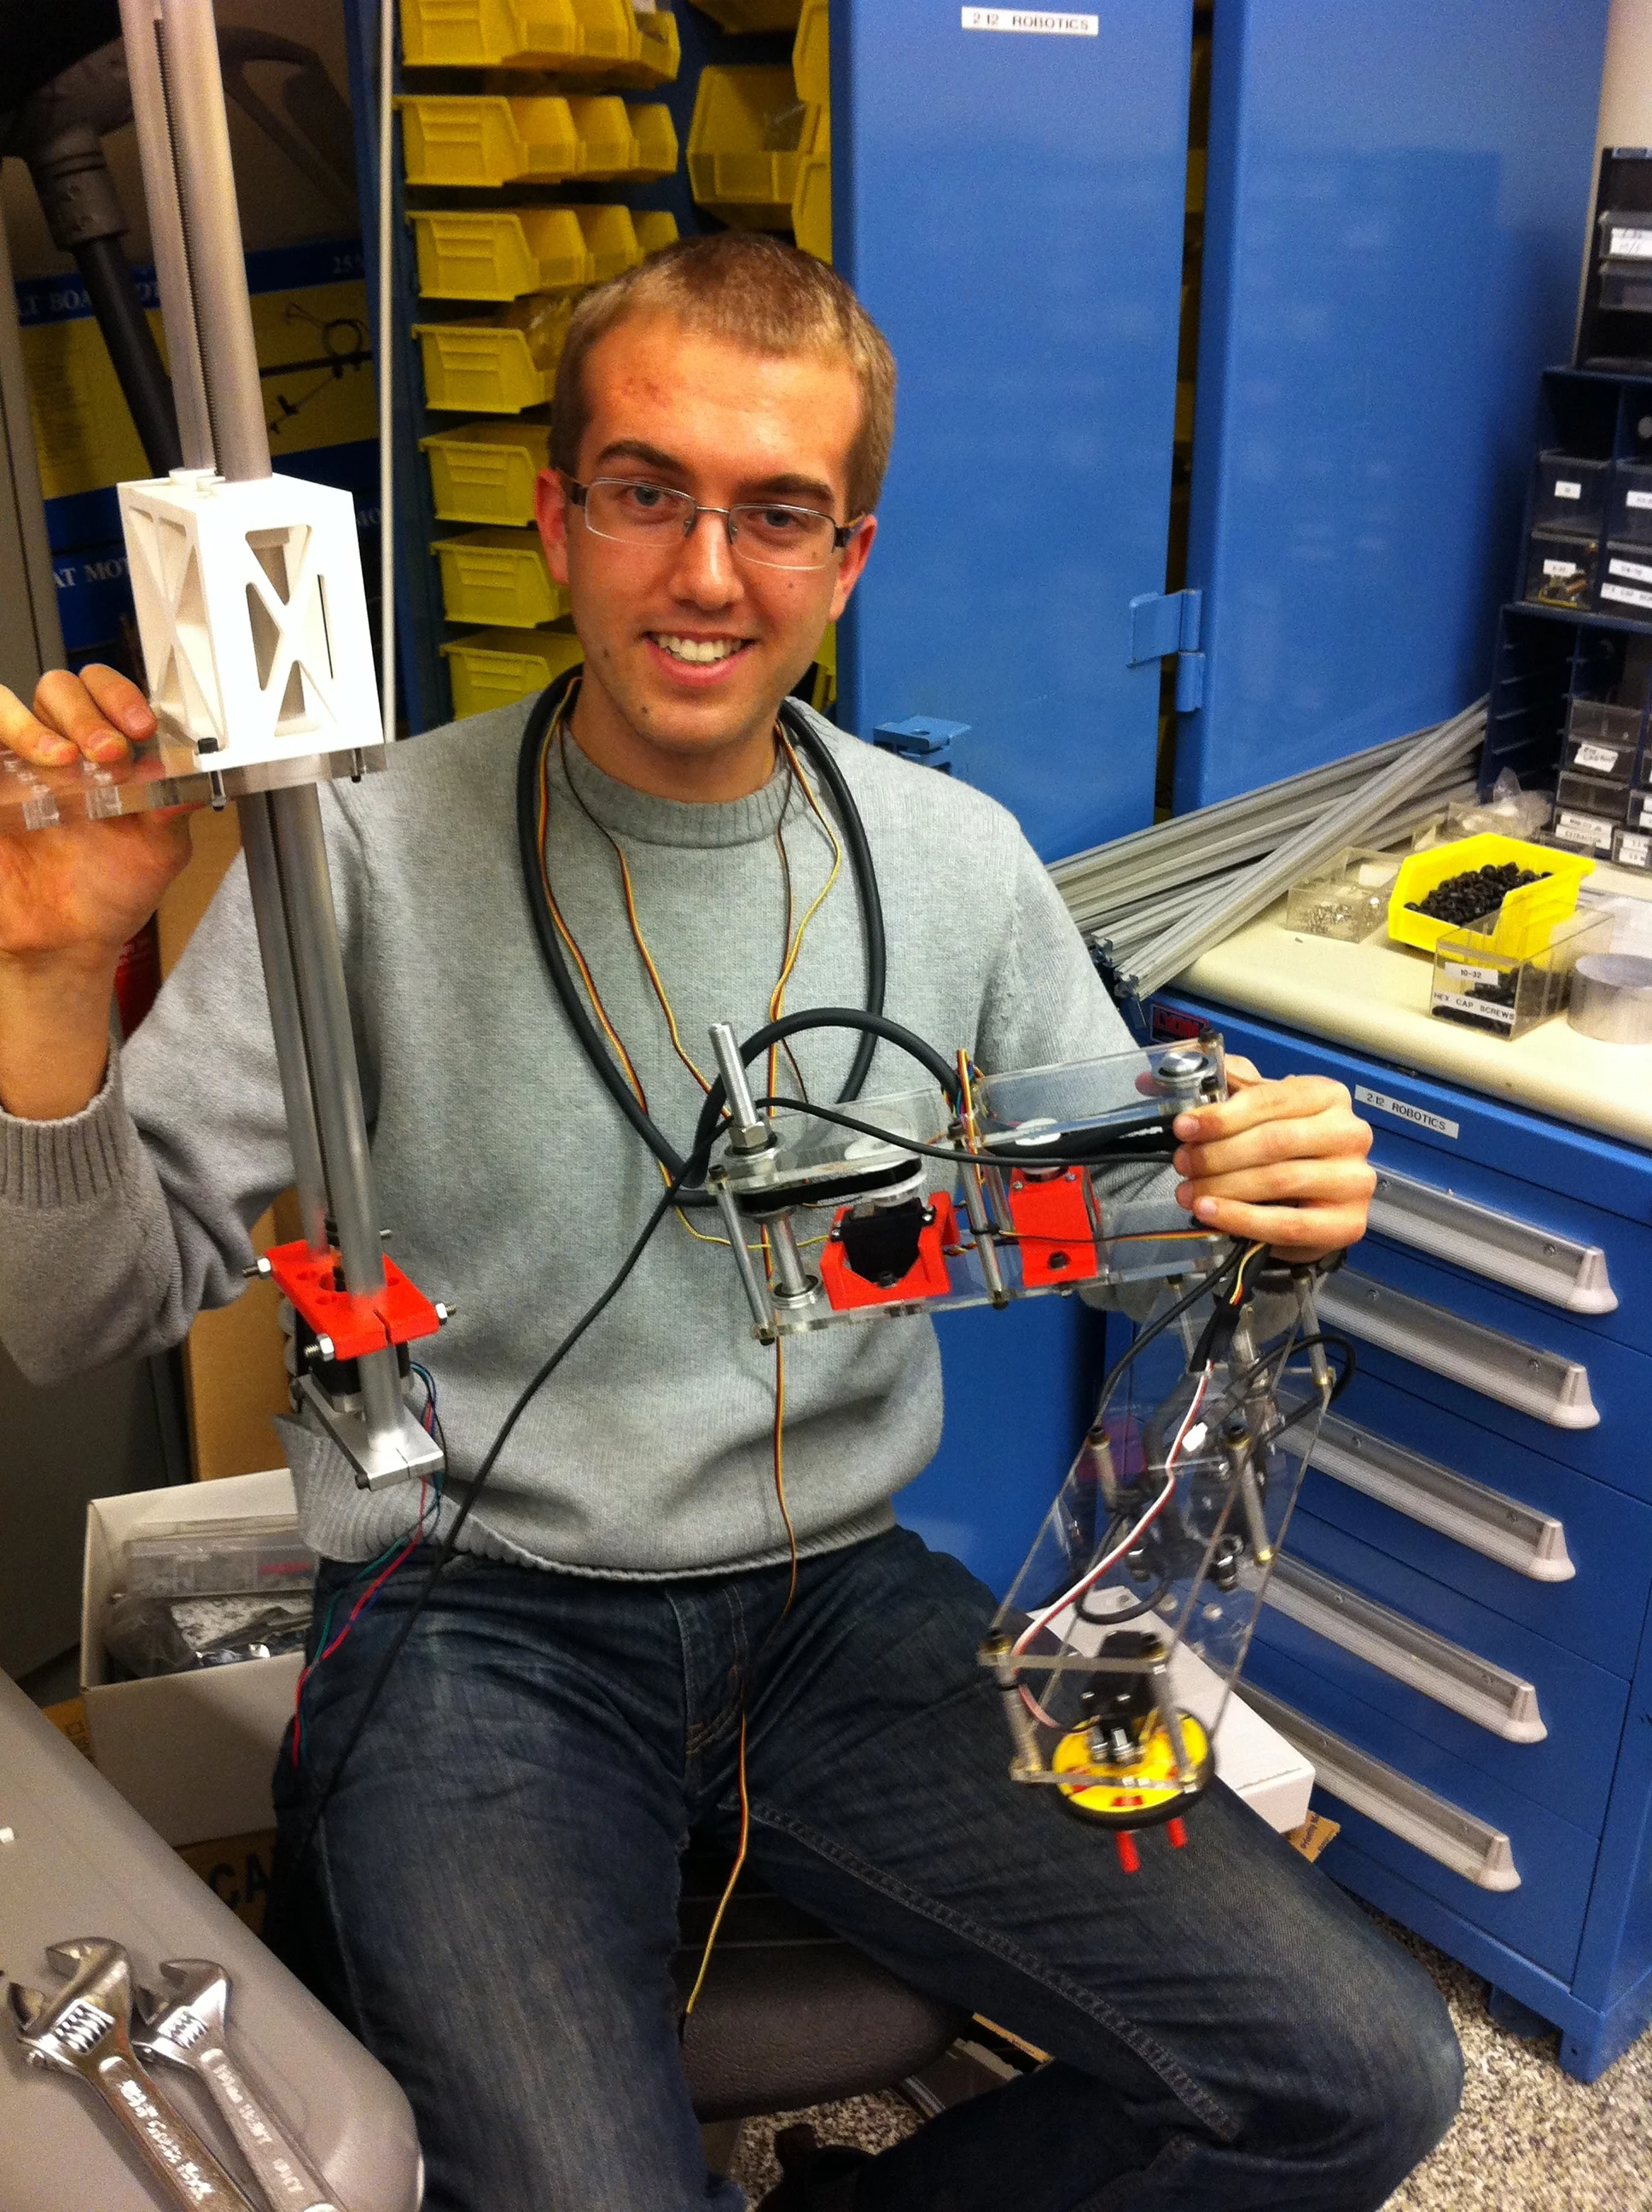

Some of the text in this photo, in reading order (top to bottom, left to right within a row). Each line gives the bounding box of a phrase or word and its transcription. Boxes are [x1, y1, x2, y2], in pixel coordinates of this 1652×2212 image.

[1012, 15, 1089, 31] ROBOTICS
[1460, 969, 1482, 980] 10-32
[1434, 991, 1515, 1021] HEX CAP SCREWS
[1391, 1102, 1446, 1131] ROBOTICS
